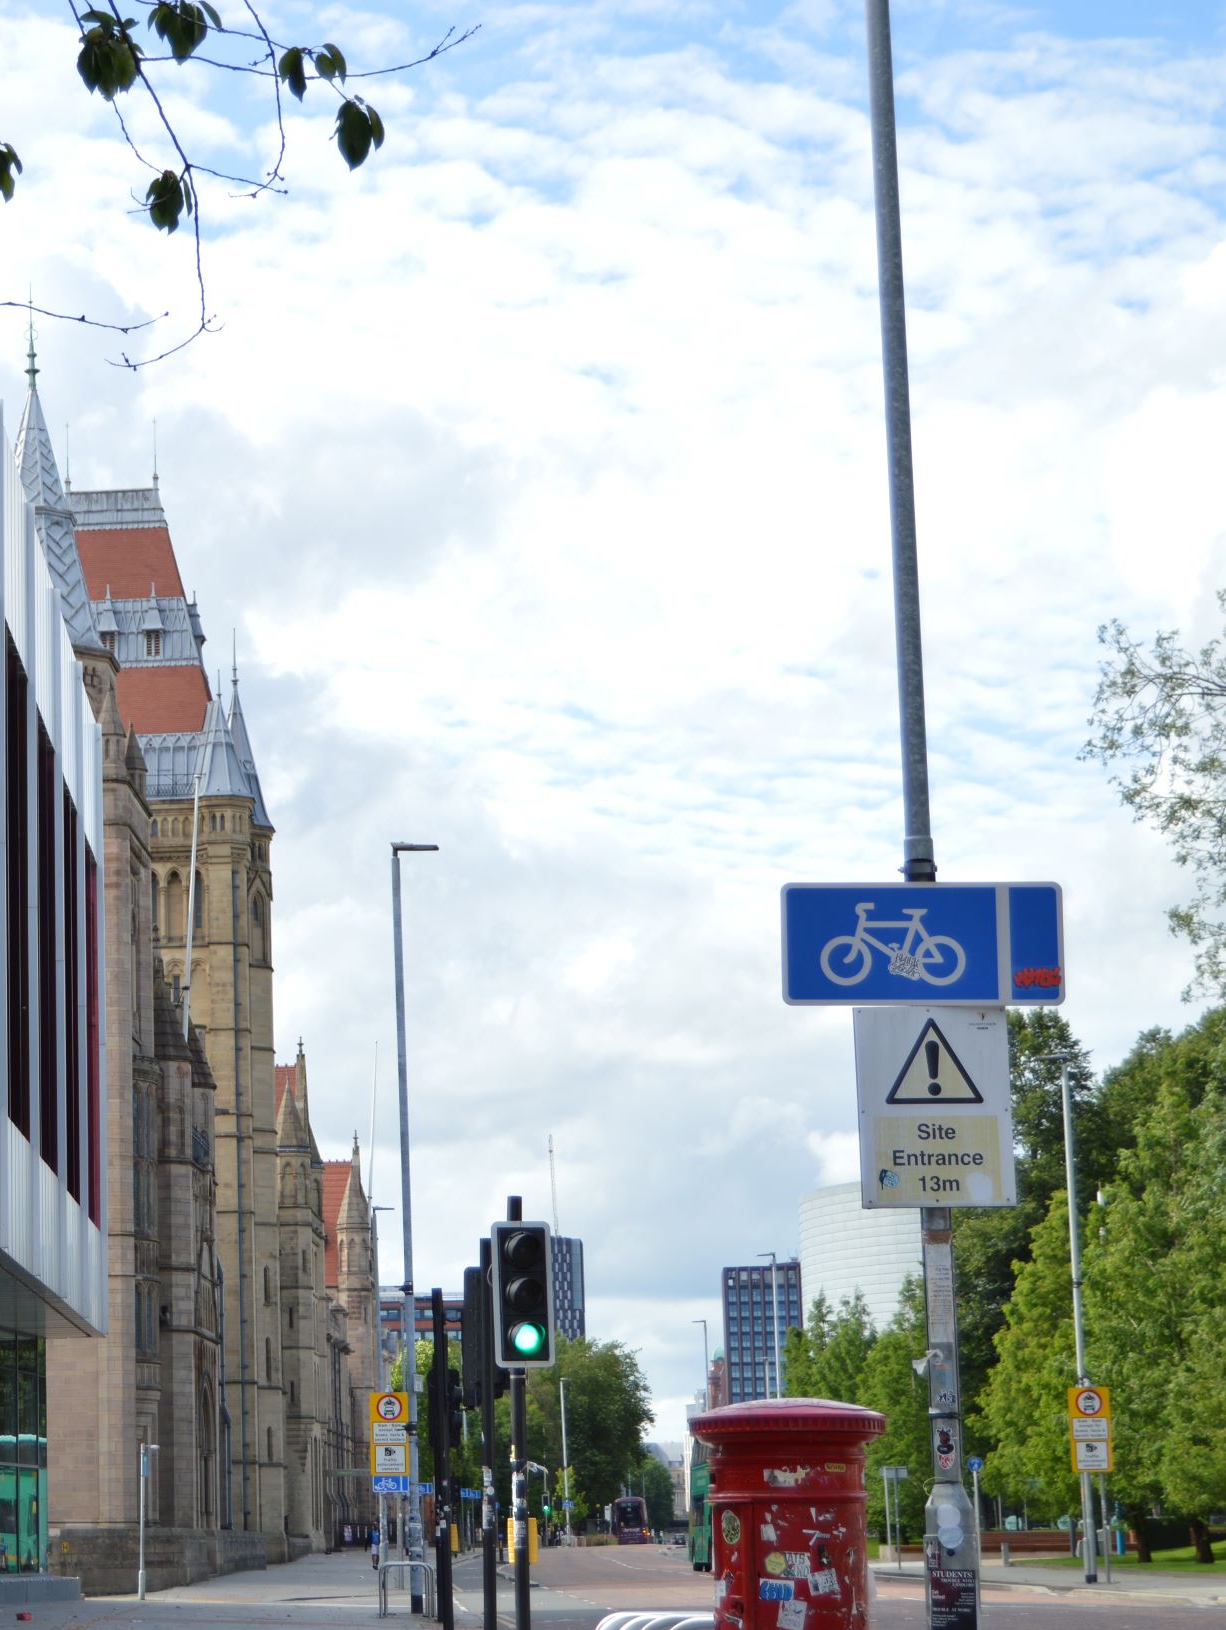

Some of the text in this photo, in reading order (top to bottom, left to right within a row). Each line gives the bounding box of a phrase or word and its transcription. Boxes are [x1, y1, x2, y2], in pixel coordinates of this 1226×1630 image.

[917, 1123, 956, 1140] Site
[892, 1149, 984, 1166] Entrance
[918, 1175, 960, 1192] 13m
